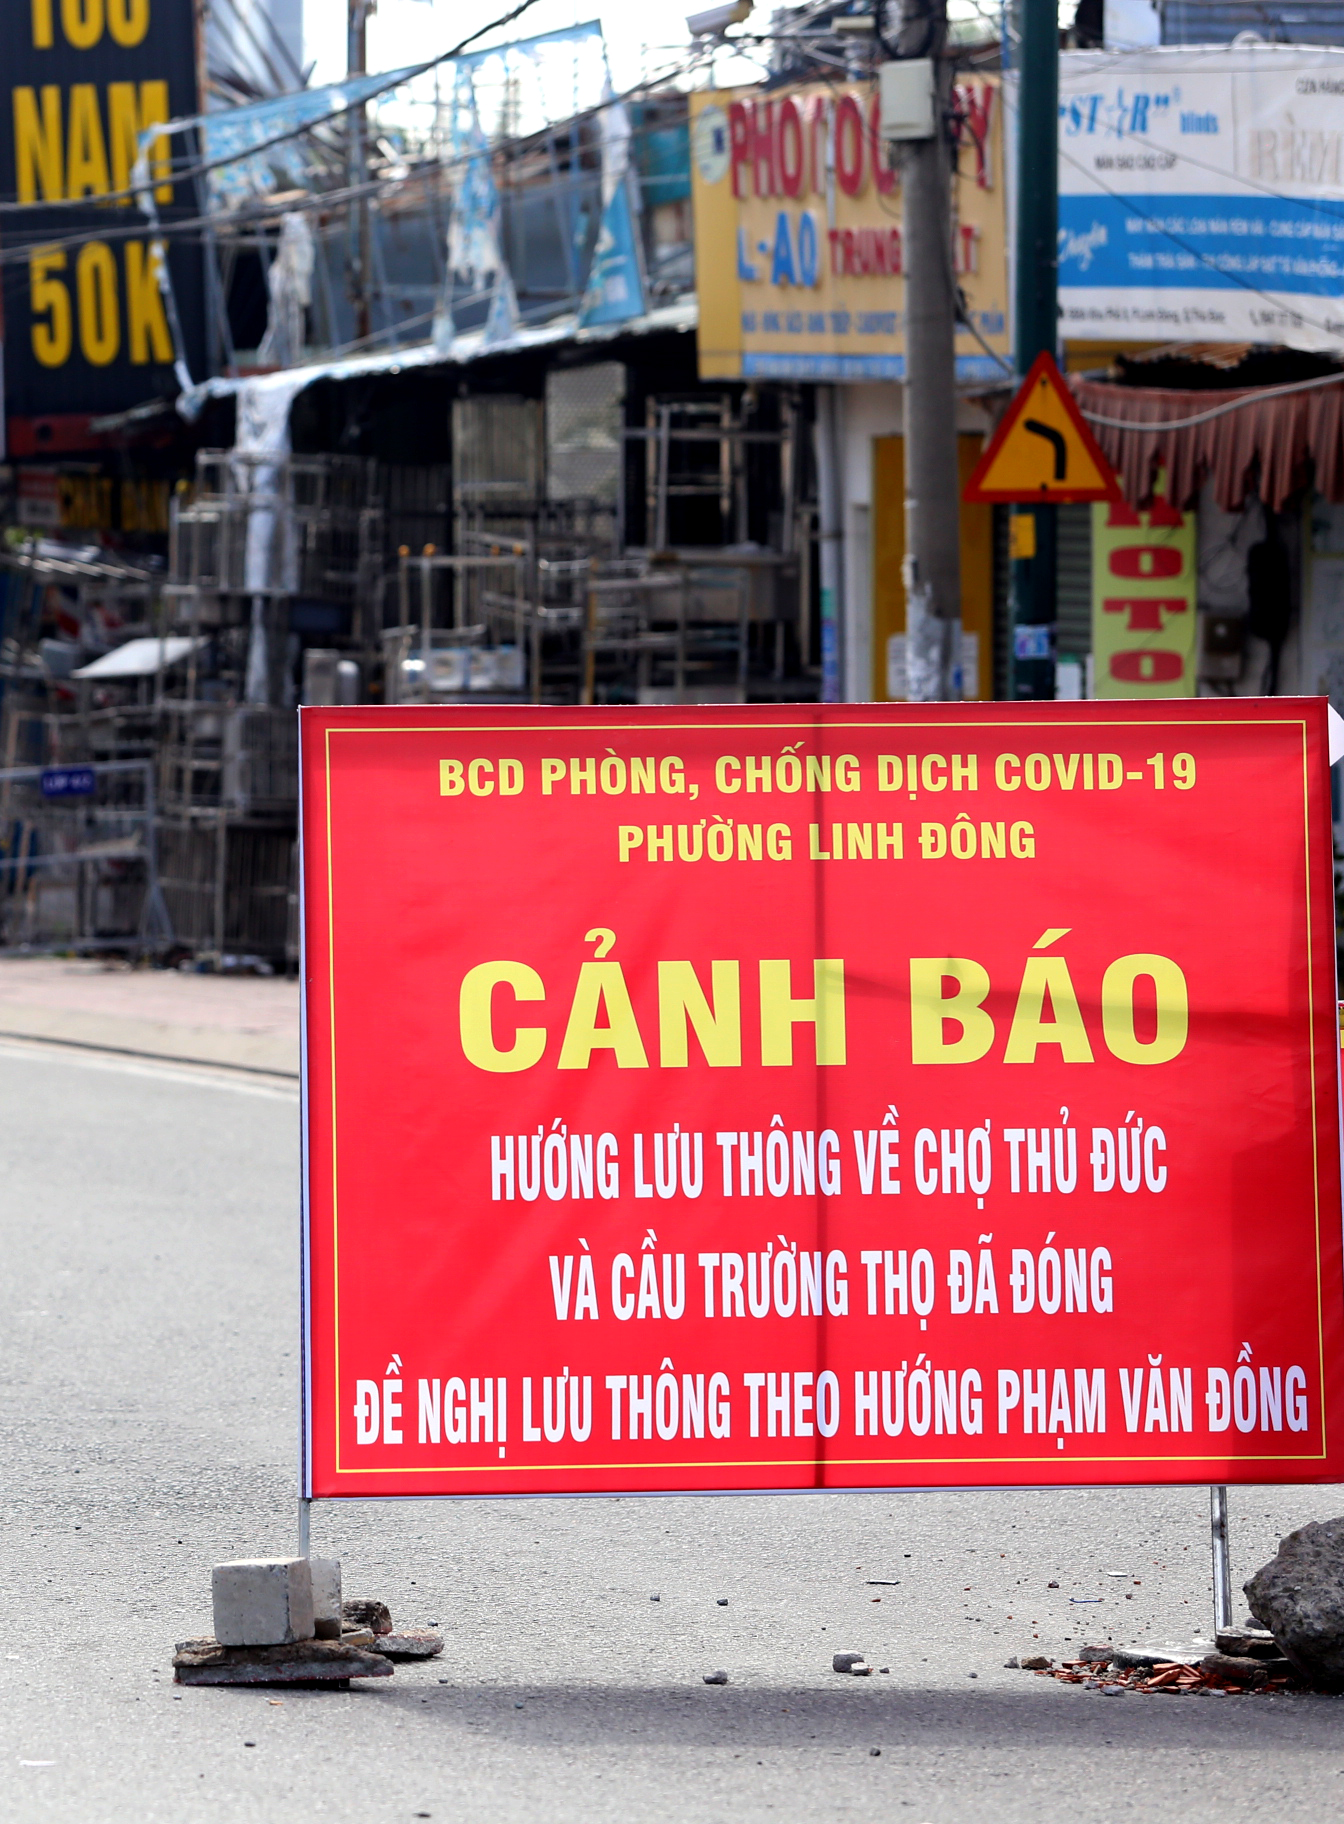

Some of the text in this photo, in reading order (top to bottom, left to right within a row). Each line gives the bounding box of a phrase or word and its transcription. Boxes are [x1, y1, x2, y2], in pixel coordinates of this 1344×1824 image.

[12, 79, 174, 207] NAM
[29, 239, 175, 368] 50K
[439, 741, 1197, 801] BCD PHÒNG, CHỐNG DỊCH COVID-19
[618, 812, 1037, 863] PHƯỜNG LINH ĐÔNG
[458, 927, 1189, 1074] CẢNH BÁO
[490, 1104, 1168, 1210] HƯỚNG LƯU THÔNG VỀ CHỢ THỦ ĐỨC
[548, 1228, 1114, 1331] VÀ CẦU TRƯỜNG THỌ ĐÃ ĐÓNG
[353, 1341, 1308, 1459] ĐỀ NGHỊ LƯU THÔNG THEO HƯỚNG PHẠM VĂN ĐỒNG
